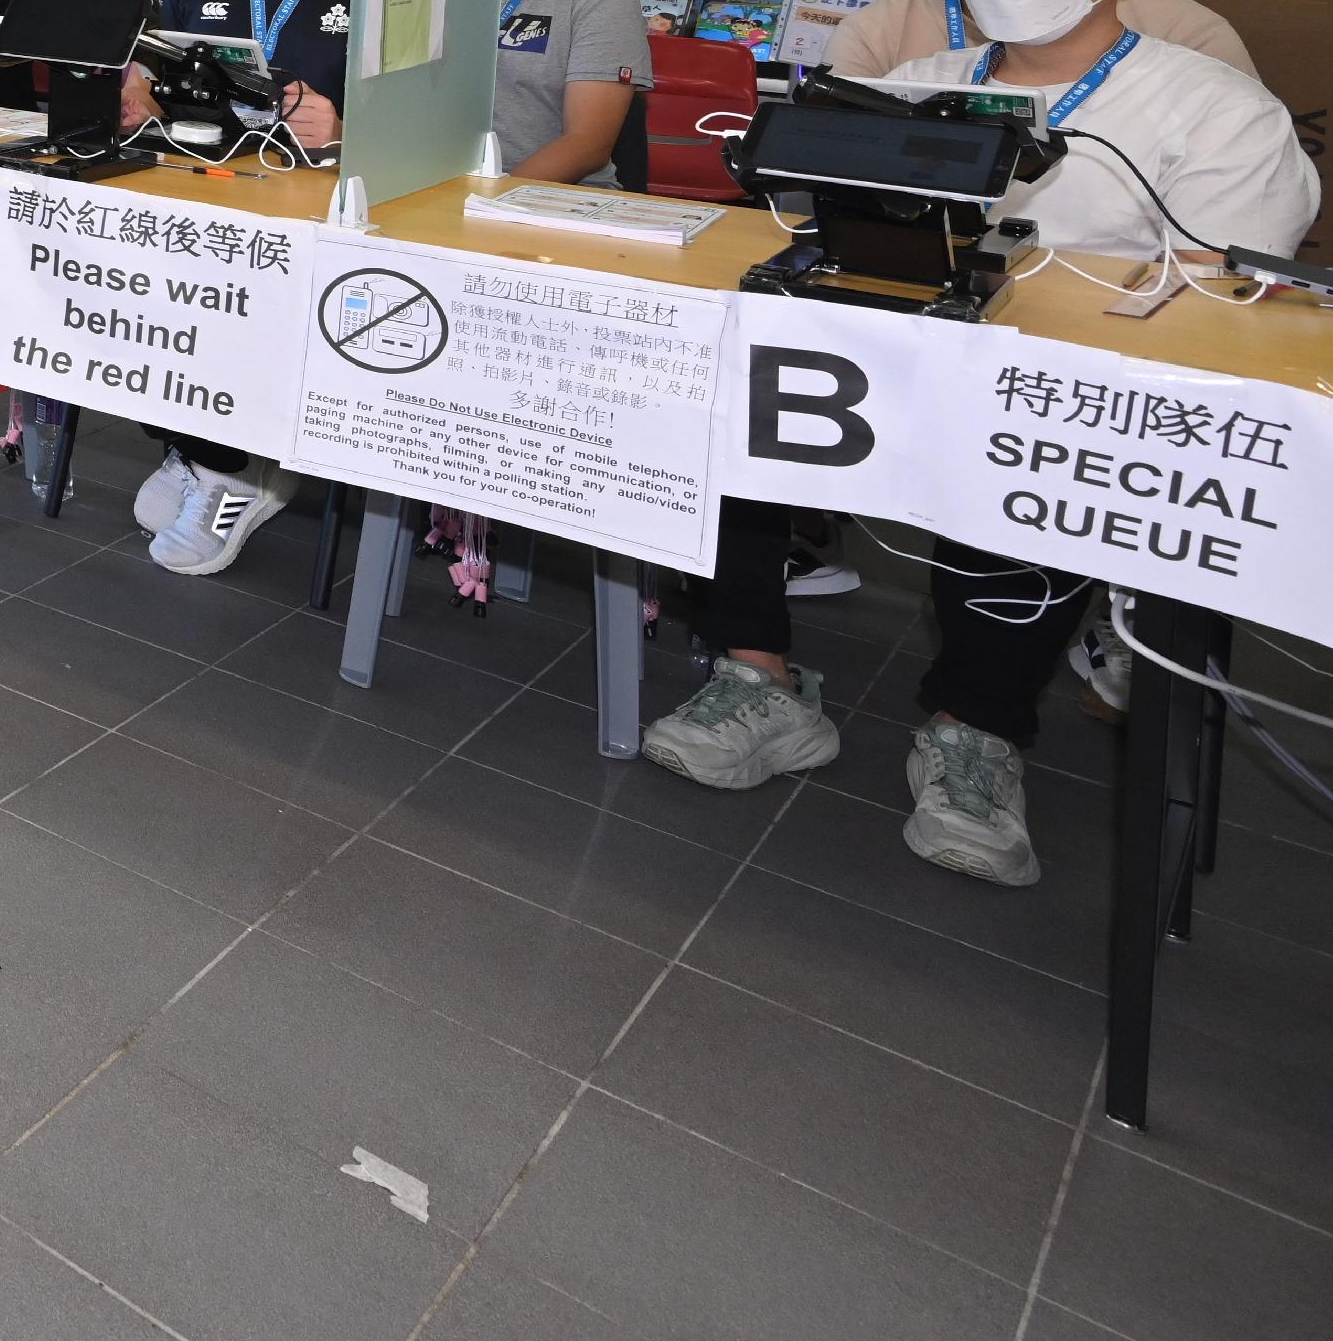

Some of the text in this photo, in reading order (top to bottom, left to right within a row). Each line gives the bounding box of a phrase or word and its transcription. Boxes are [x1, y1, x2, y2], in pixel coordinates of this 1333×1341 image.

[7, 185, 292, 275] 請於紅線後等候
[30, 243, 250, 317] Please wait
[463, 272, 679, 327] 請勿使用電子器材
[64, 297, 198, 356] behind
[13, 335, 235, 416] the red line
[386, 388, 614, 447] Please Do Not Use Electronic Device
[748, 343, 876, 468] B
[995, 366, 1292, 471] 特別隊伍
[302, 428, 588, 502] recording is prohibited within a polling station.
[304, 416, 697, 516] taking photographs, filming, or making any audio/video
[306, 403, 698, 501] paging machine or any other device for communication, or
[307, 391, 699, 488] Except for authorized persons, use of mobile telephone,
[985, 432, 1278, 529] SPECIAL
[392, 458, 597, 519] Thank you for your co-operation!
[1002, 491, 1242, 577] QUEUE
